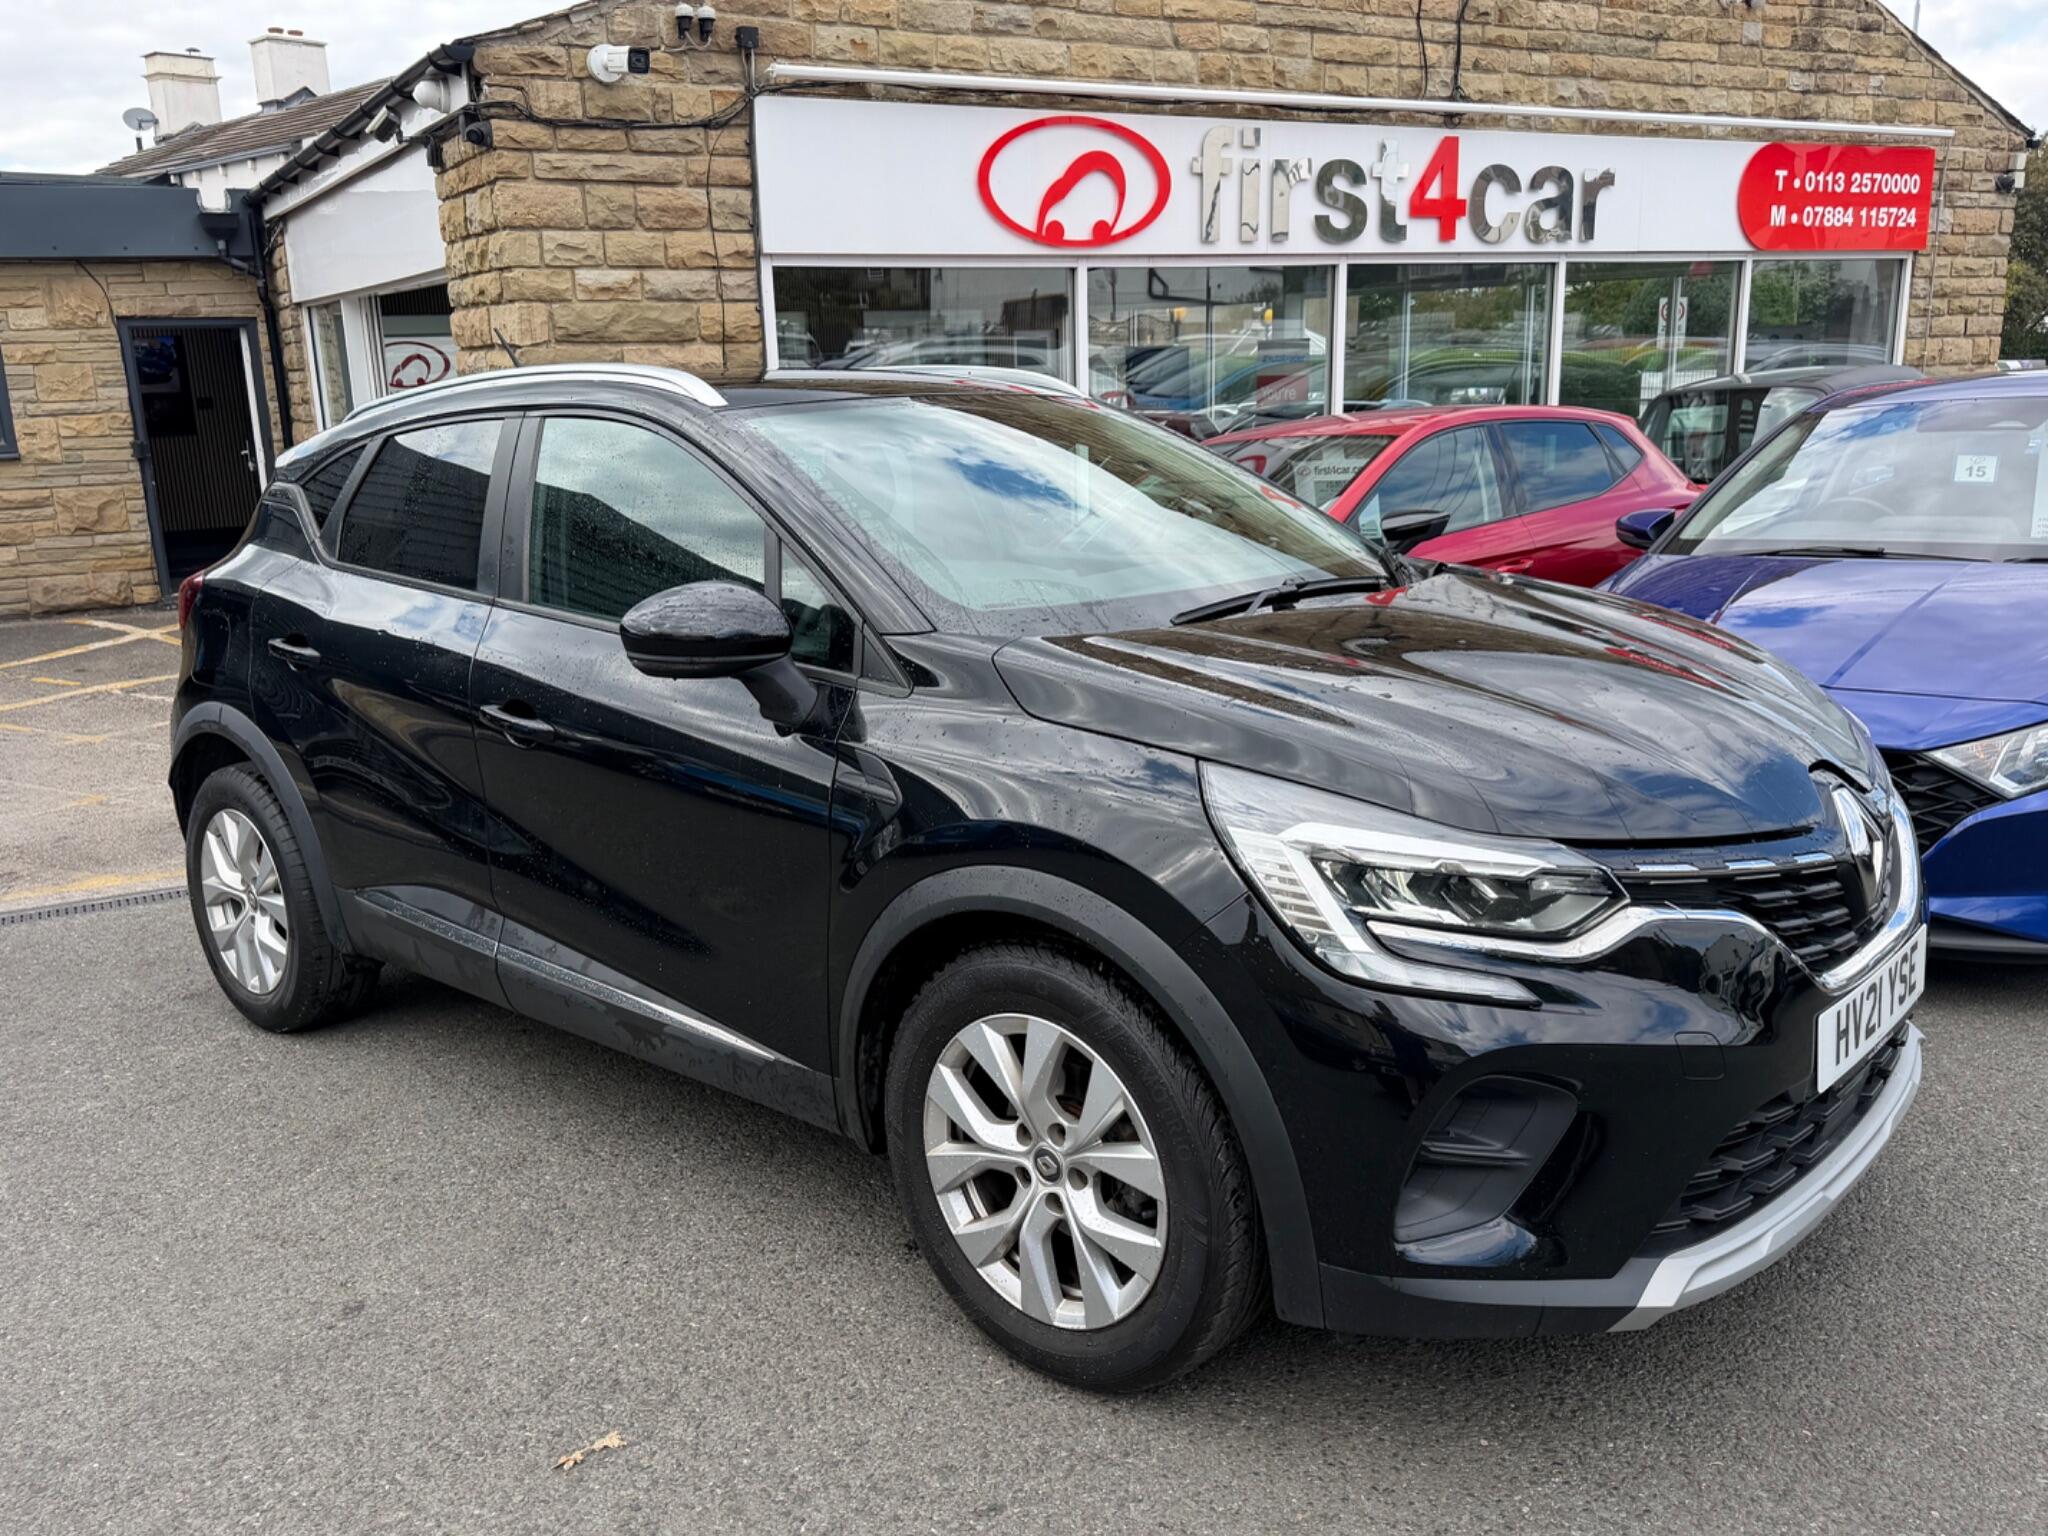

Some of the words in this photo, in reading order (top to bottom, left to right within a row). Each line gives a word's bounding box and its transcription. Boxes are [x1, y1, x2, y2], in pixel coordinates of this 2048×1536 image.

[1191, 125, 1616, 243] first4car
[1774, 169, 1788, 192] T
[1804, 170, 1846, 193] 0113
[1850, 172, 1921, 194] 2570000
[1770, 204, 1787, 226] M
[1802, 206, 1854, 227] 07884
[1859, 207, 1917, 228] 115724
[1965, 465, 1987, 478] 15
[1835, 975, 1883, 1066] HV21
[1888, 941, 1918, 1017] YSE
